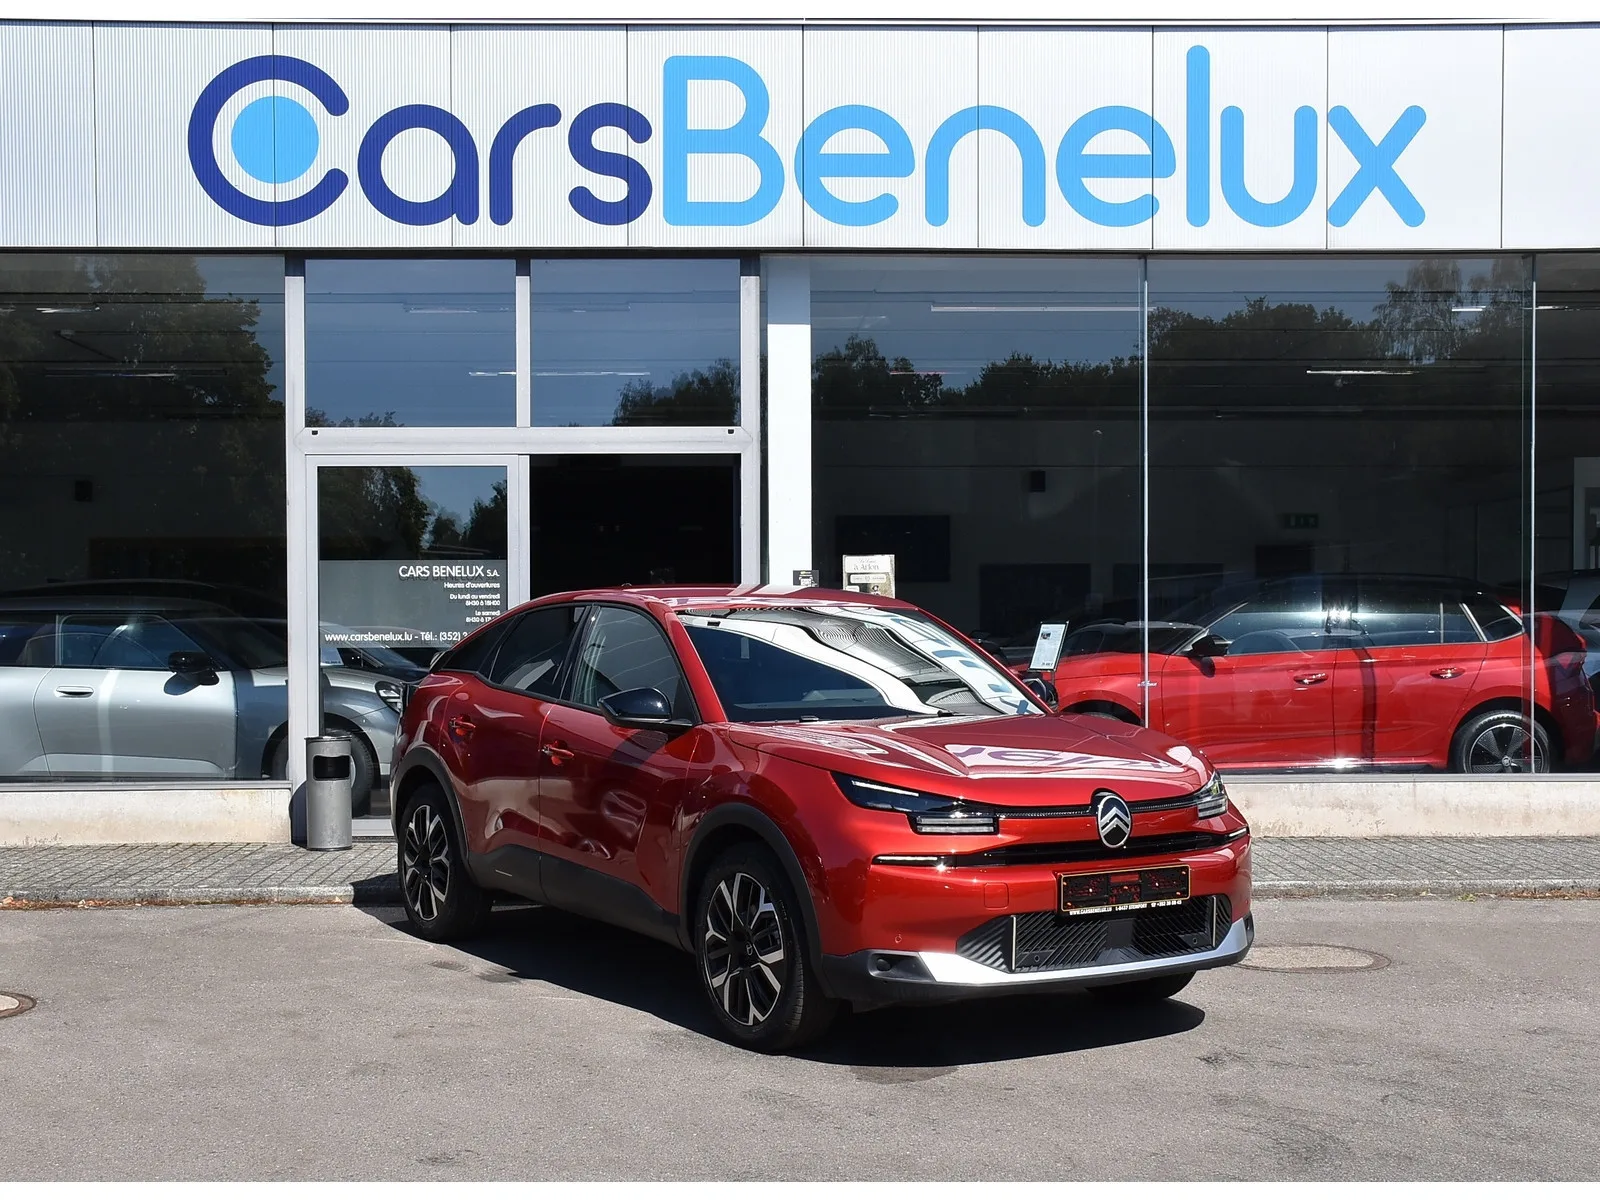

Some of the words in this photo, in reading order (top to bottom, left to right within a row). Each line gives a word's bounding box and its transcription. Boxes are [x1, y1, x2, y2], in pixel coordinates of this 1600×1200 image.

[399, 565, 430, 577] CARS
[432, 565, 484, 577] BENELUX
[486, 569, 500, 577] S.A.
[325, 631, 412, 642] www.carsbenelux.lu
[421, 631, 437, 641] Tél.:
[439, 631, 461, 642] (352)
